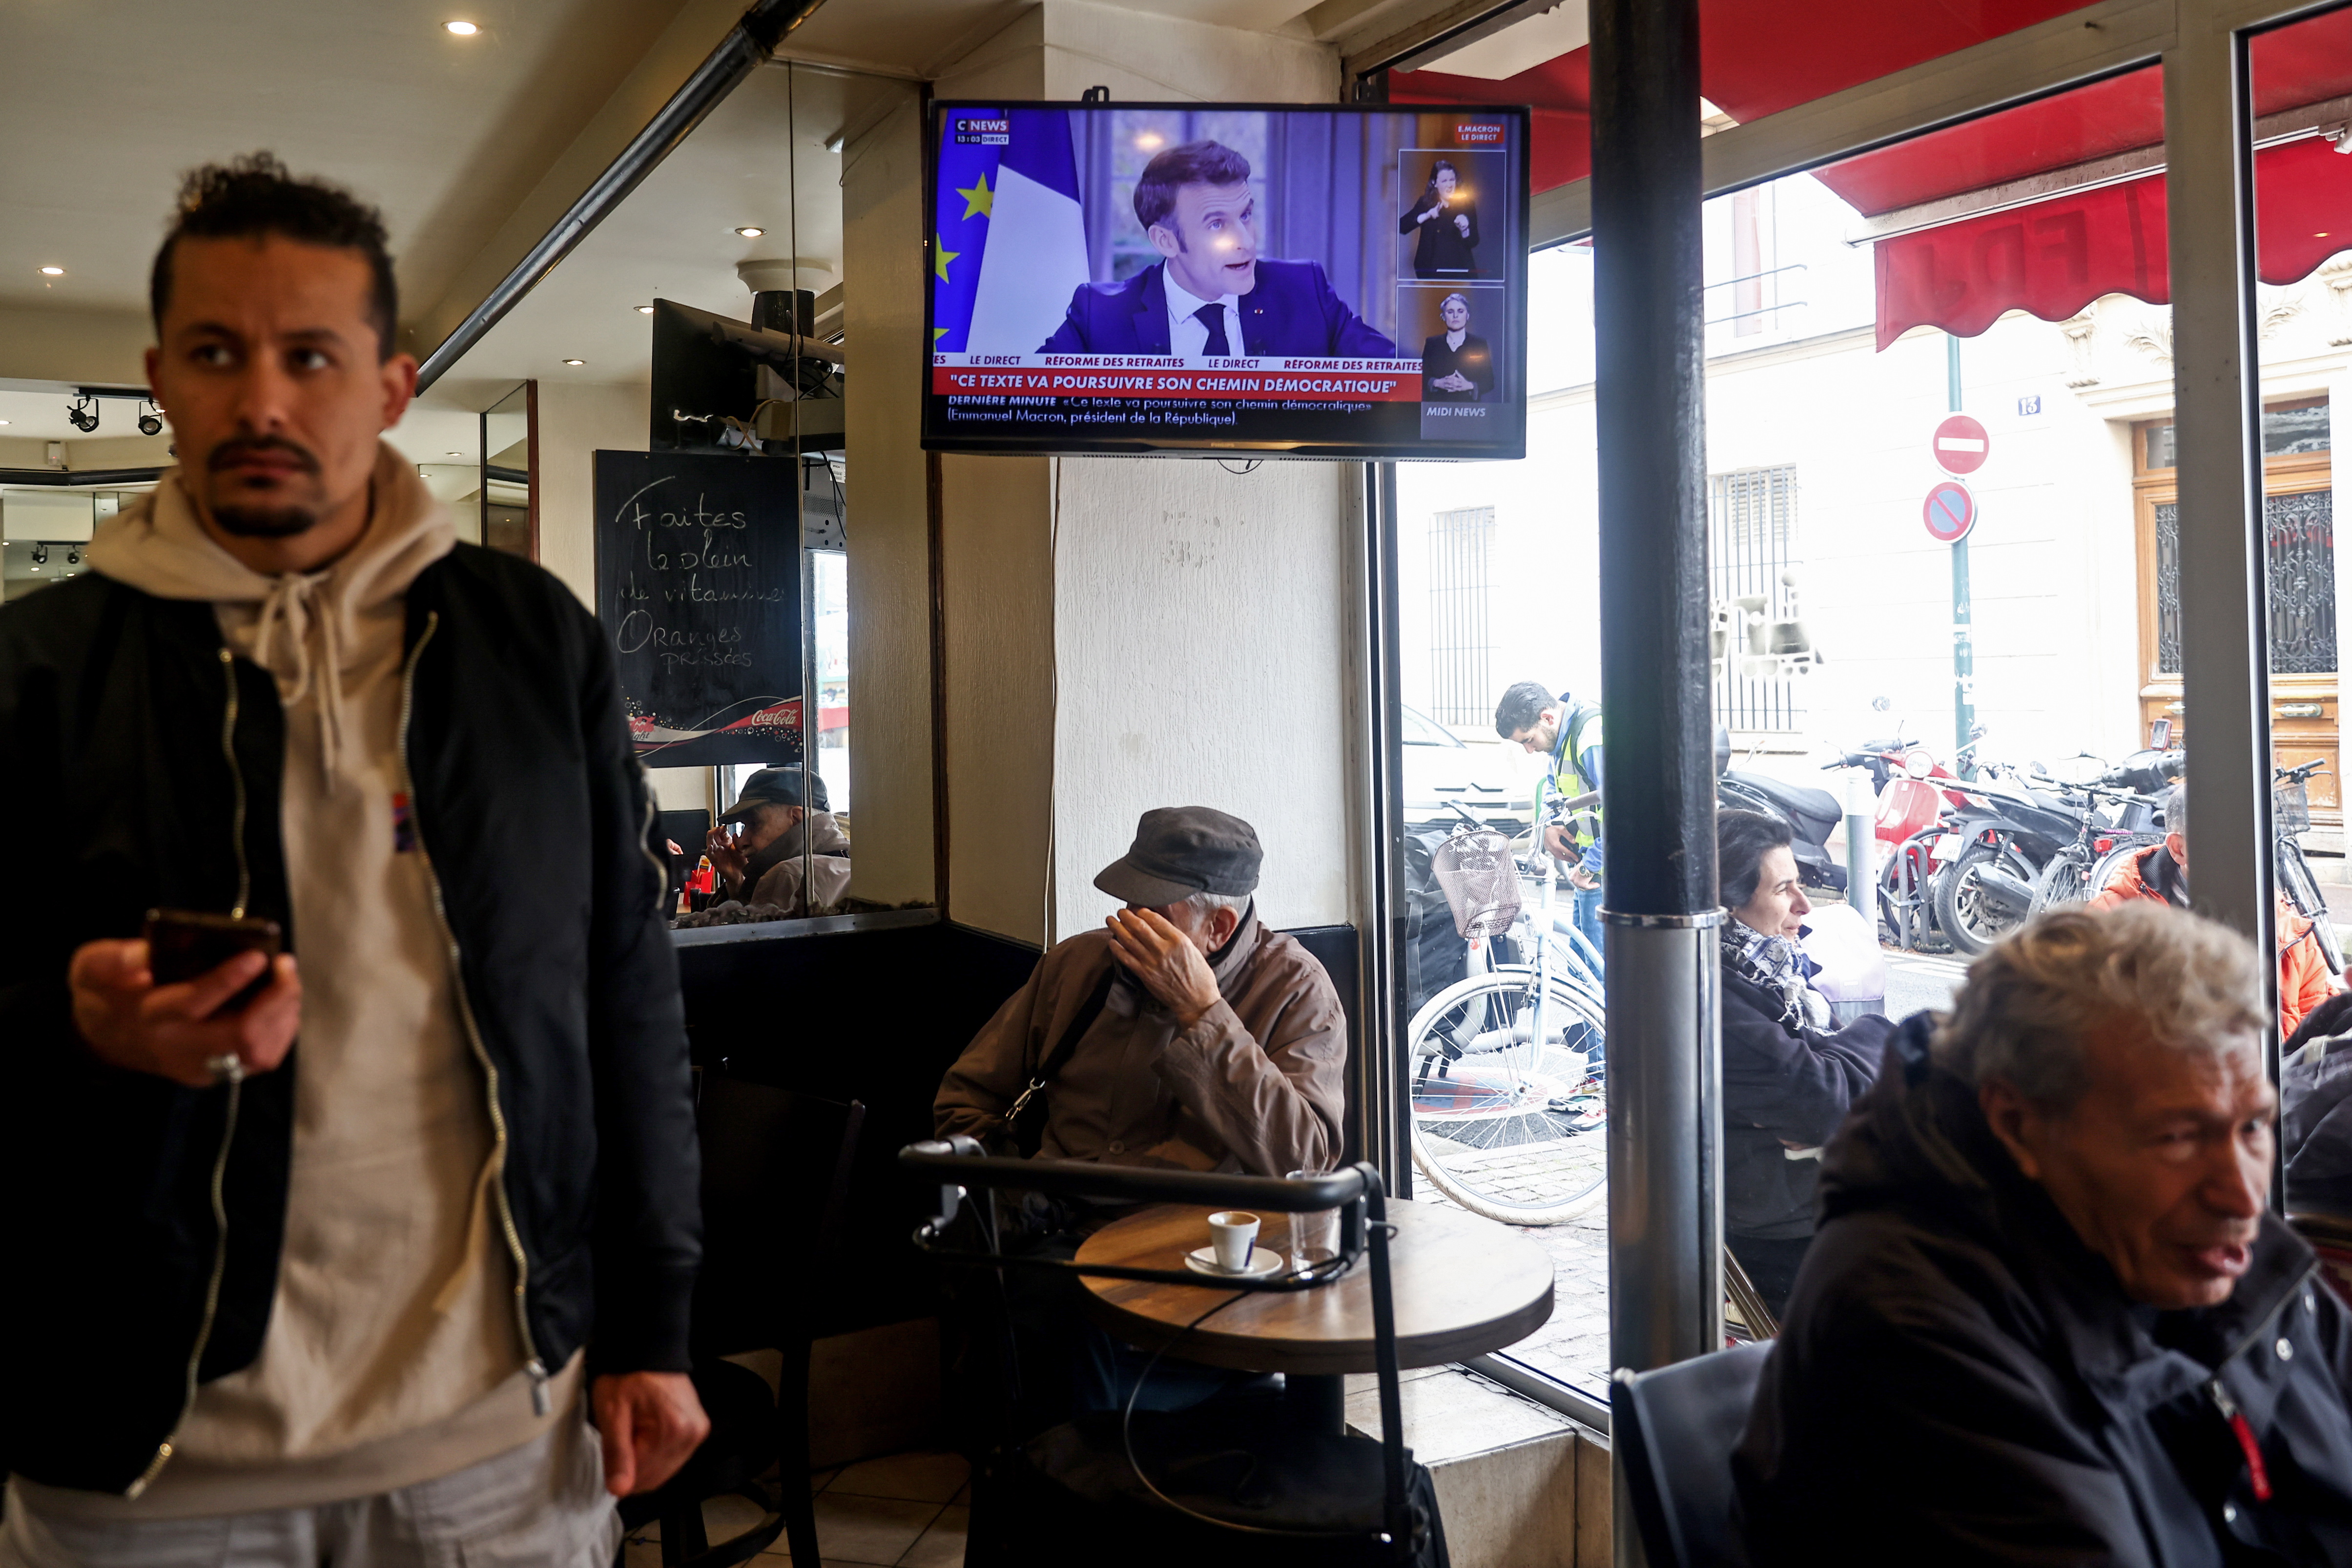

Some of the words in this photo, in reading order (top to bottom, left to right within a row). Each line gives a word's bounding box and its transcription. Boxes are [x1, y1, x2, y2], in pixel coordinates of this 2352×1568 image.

[933, 355, 946, 364] ES
[970, 356, 980, 365] LE
[984, 356, 1021, 365] DIRECT
[1045, 356, 1100, 366] RÉFORME
[1103, 358, 1123, 367] DES
[1127, 358, 1184, 367] RETRAITES
[1209, 359, 1219, 368] LE
[1223, 359, 1259, 369] DIRECT
[1284, 360, 1339, 370] RÉFORME
[1342, 361, 1362, 370] DES
[1366, 362, 1423, 371] RETRAITES
[950, 374, 976, 387] "CE
[980, 374, 1023, 388] TEXTE
[1027, 375, 1049, 388] VA
[1053, 375, 1154, 390] POURSUIVRE
[1156, 377, 1193, 390] SON
[1196, 378, 1260, 391] CHEMIN
[1264, 377, 1397, 393] DÉMOCRATIQUE"
[948, 395, 1006, 406] DERNIÈRE
[1009, 396, 1056, 406] MINUTE
[1125, 399, 1140, 408] va
[1144, 398, 1206, 411] poursuivre
[1211, 400, 1231, 409] son
[1236, 399, 1278, 410] chemin
[1426, 407, 1452, 416] MIDI
[1454, 408, 1486, 417] NEWS
[2021, 397, 2038, 415] 13
[948, 407, 1012, 422] (Emmanuel
[1016, 409, 1066, 424] Macron,
[1071, 411, 1126, 426] président
[1130, 411, 1145, 424] de
[1150, 412, 1160, 424] la
[615, 475, 746, 530] Faites
[665, 573, 784, 602] vitamine
[751, 708, 799, 725] Coca-Cola
